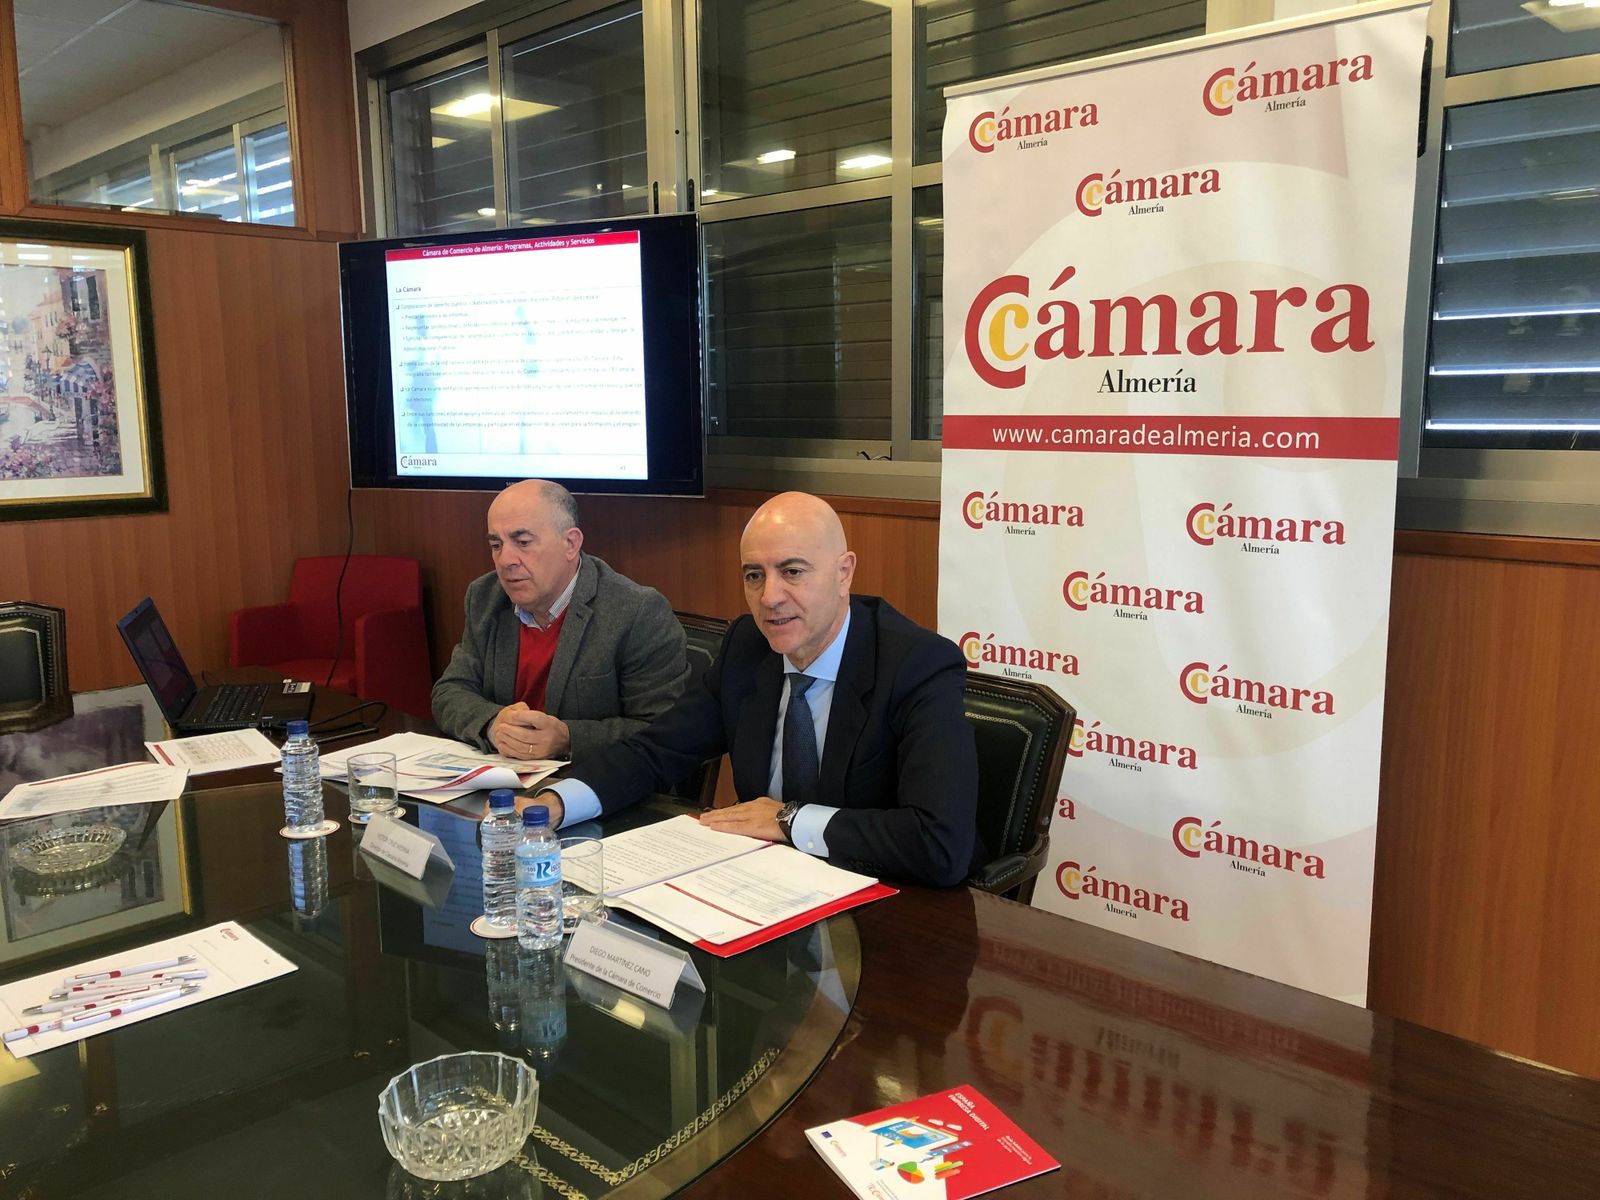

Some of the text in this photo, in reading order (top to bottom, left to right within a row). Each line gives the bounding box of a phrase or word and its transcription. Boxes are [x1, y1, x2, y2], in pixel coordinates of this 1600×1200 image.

[1202, 53, 1374, 116] Cámara
[1264, 97, 1306, 113] Almería
[968, 102, 1099, 154] Cámara
[1016, 137, 1048, 151] Almería
[1076, 168, 1221, 217] Cámara
[1128, 203, 1164, 216] Almería
[504, 242, 533, 251] Programas,
[534, 240, 565, 248] Actividades
[964, 266, 1376, 389] Cámara
[1097, 368, 1197, 394] Almería
[992, 424, 1320, 450] www.camaradealmeria.com
[400, 455, 437, 468] Cámara
[962, 491, 1084, 530] Cámara
[1004, 525, 1036, 536] Almería
[1186, 502, 1346, 546] Cámara
[1240, 542, 1280, 556] Almería
[1062, 570, 1204, 614] Cámara
[1113, 608, 1148, 621] Almería
[958, 631, 1080, 676] Cámara
[1180, 662, 1336, 716] Cámara
[1236, 704, 1272, 719] Almería
[1108, 758, 1142, 772] Almería
[1172, 816, 1326, 880] Cámara
[1229, 860, 1266, 878] Almería
[1055, 861, 1190, 922] Cámara
[1104, 903, 1137, 920] Almería
[589, 946, 606, 958] DIEGO
[634, 964, 651, 977] CANO
[570, 954, 661, 999] Presidente de la Cámara de Comercio
[969, 1112, 990, 1130] DIGITAL
